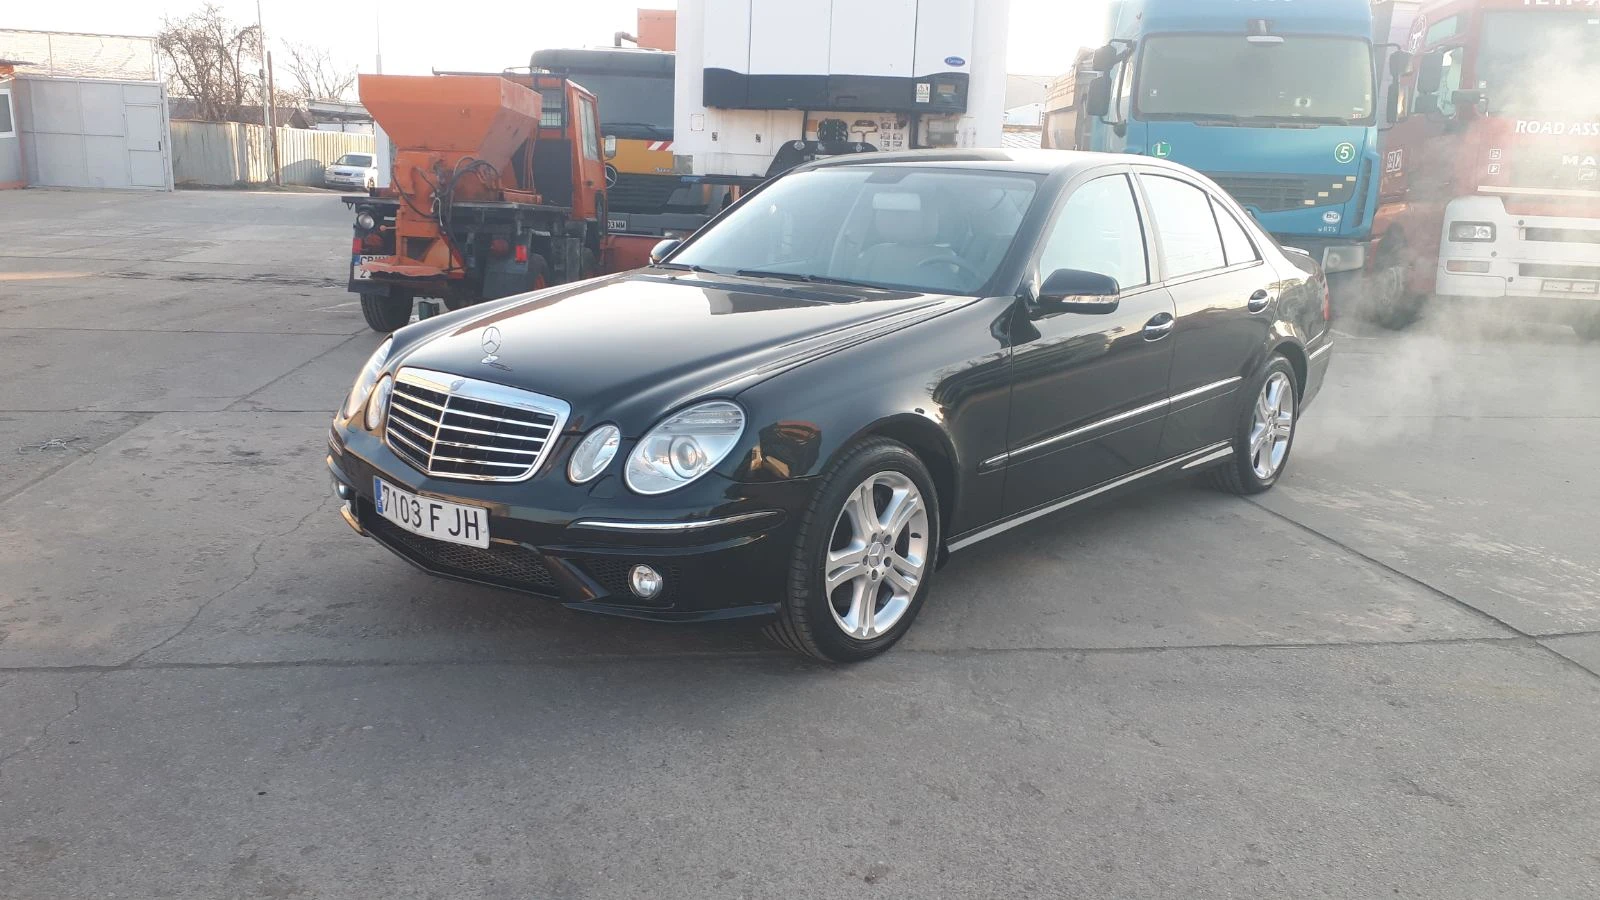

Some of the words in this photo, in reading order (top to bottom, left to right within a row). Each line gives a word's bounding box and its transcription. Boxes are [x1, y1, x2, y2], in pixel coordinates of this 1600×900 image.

[1515, 120, 1565, 134] ROAD
[1568, 122, 1600, 136] ASS
[1157, 143, 1166, 156] L
[1340, 146, 1350, 159] 5
[383, 485, 422, 528] 7103
